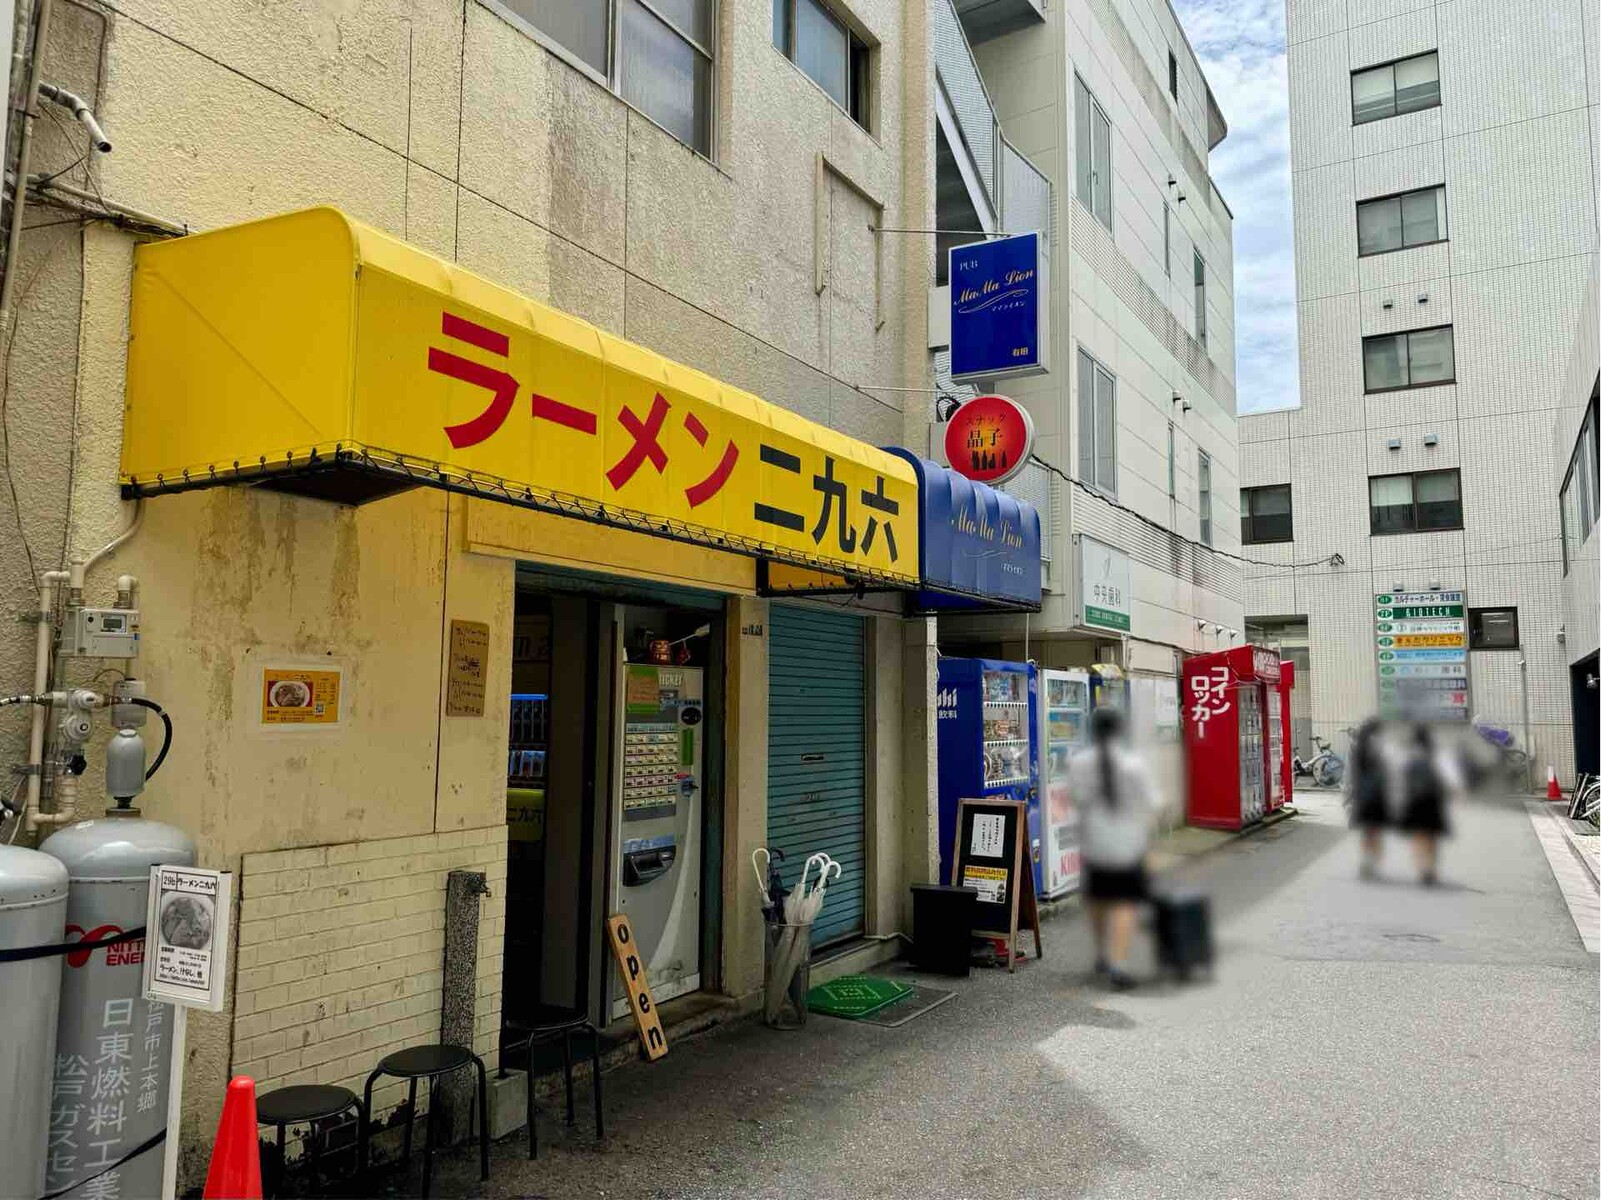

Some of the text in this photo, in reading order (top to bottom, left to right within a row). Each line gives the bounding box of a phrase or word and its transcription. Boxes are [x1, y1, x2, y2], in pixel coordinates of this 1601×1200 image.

[959, 260, 978, 271] PUB
[1005, 268, 1034, 286] Lion
[966, 413, 1007, 427] スナック
[967, 427, 1003, 449] 晶子
[1210, 665, 1231, 715] コイン
[1190, 675, 1212, 739] ロッカー
[617, 923, 663, 1050] open
